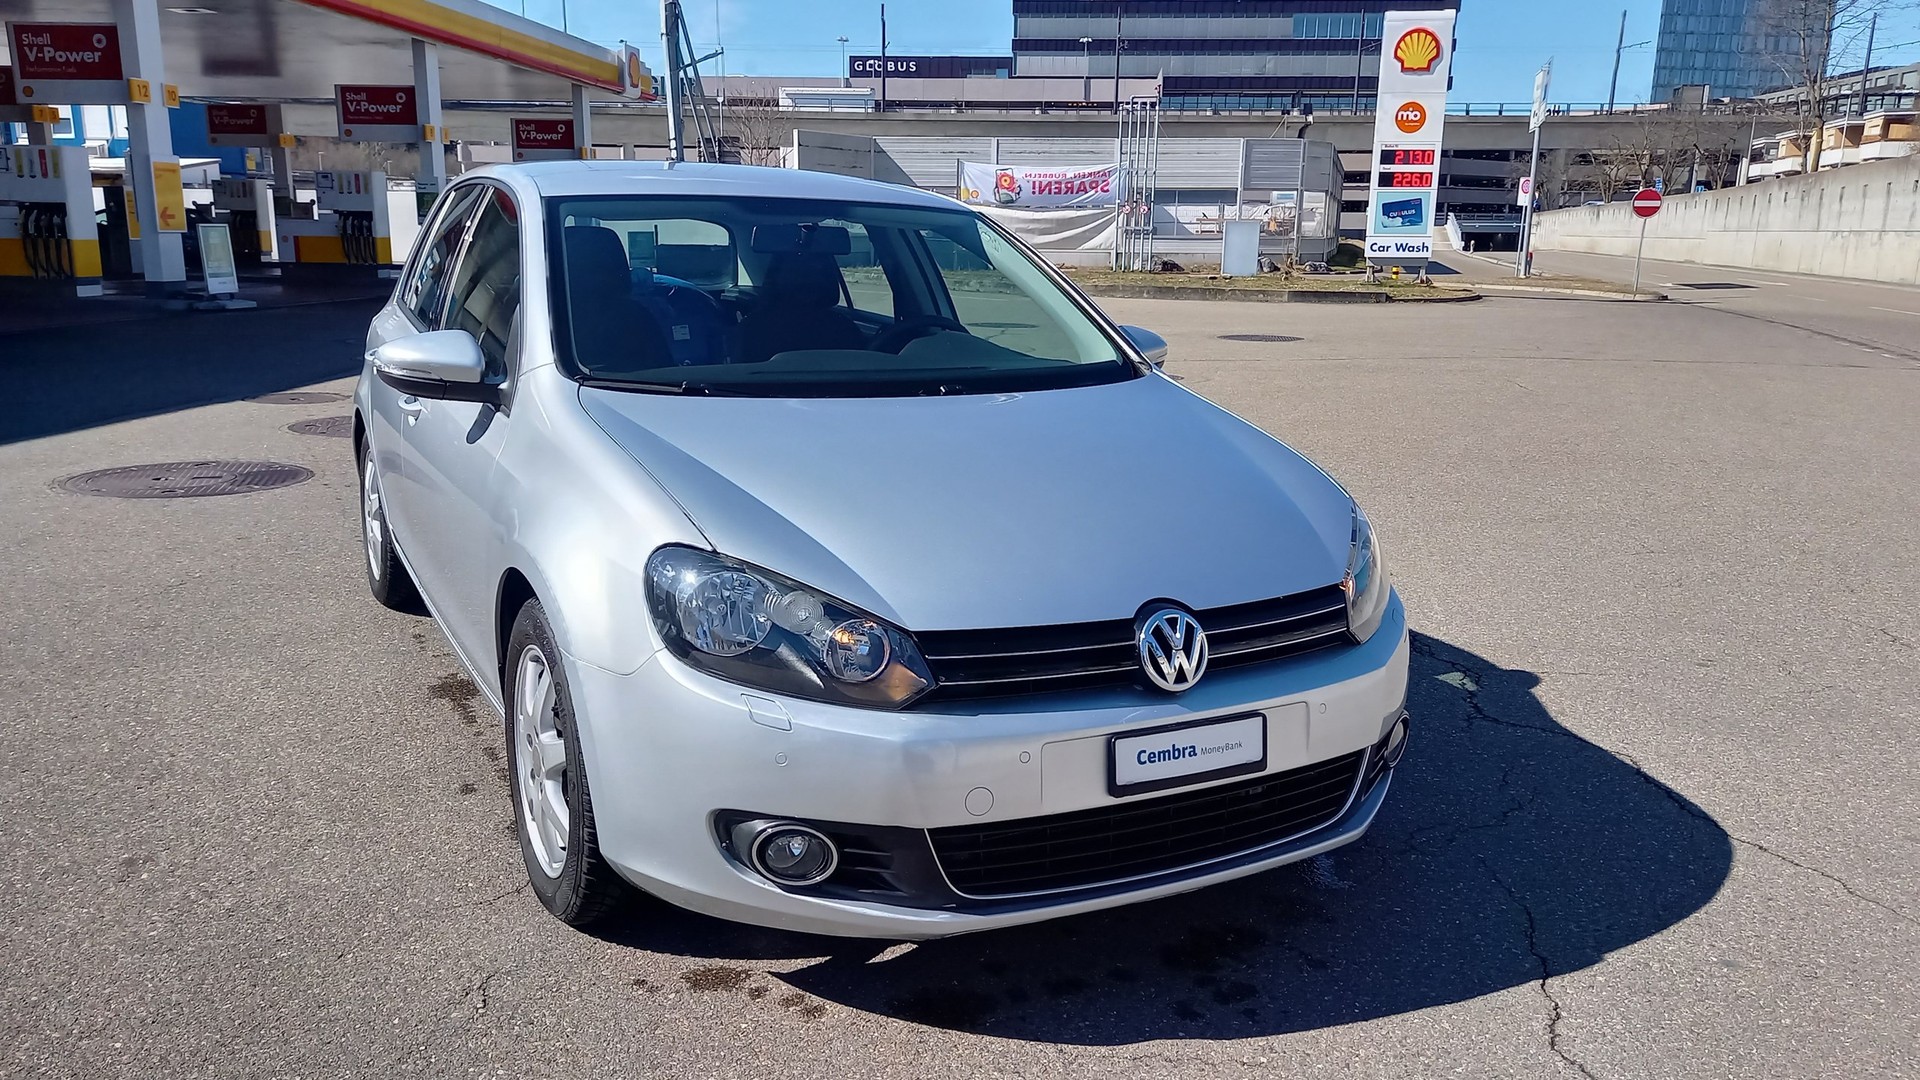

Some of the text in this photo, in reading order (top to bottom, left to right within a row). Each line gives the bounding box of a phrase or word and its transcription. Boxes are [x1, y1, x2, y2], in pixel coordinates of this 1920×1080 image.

[21, 33, 51, 45] Shell
[23, 47, 102, 63] V-Power
[854, 61, 917, 72] GLOBUS
[136, 84, 149, 97] 12
[167, 90, 177, 101] 10
[346, 92, 367, 101] Shell
[346, 101, 402, 113] V-Power
[519, 131, 562, 140] V-Power
[1393, 173, 1432, 187] 226.0
[1370, 241, 1429, 252] Car Wash
[1136, 740, 1243, 765] Cembra MoneyBank
